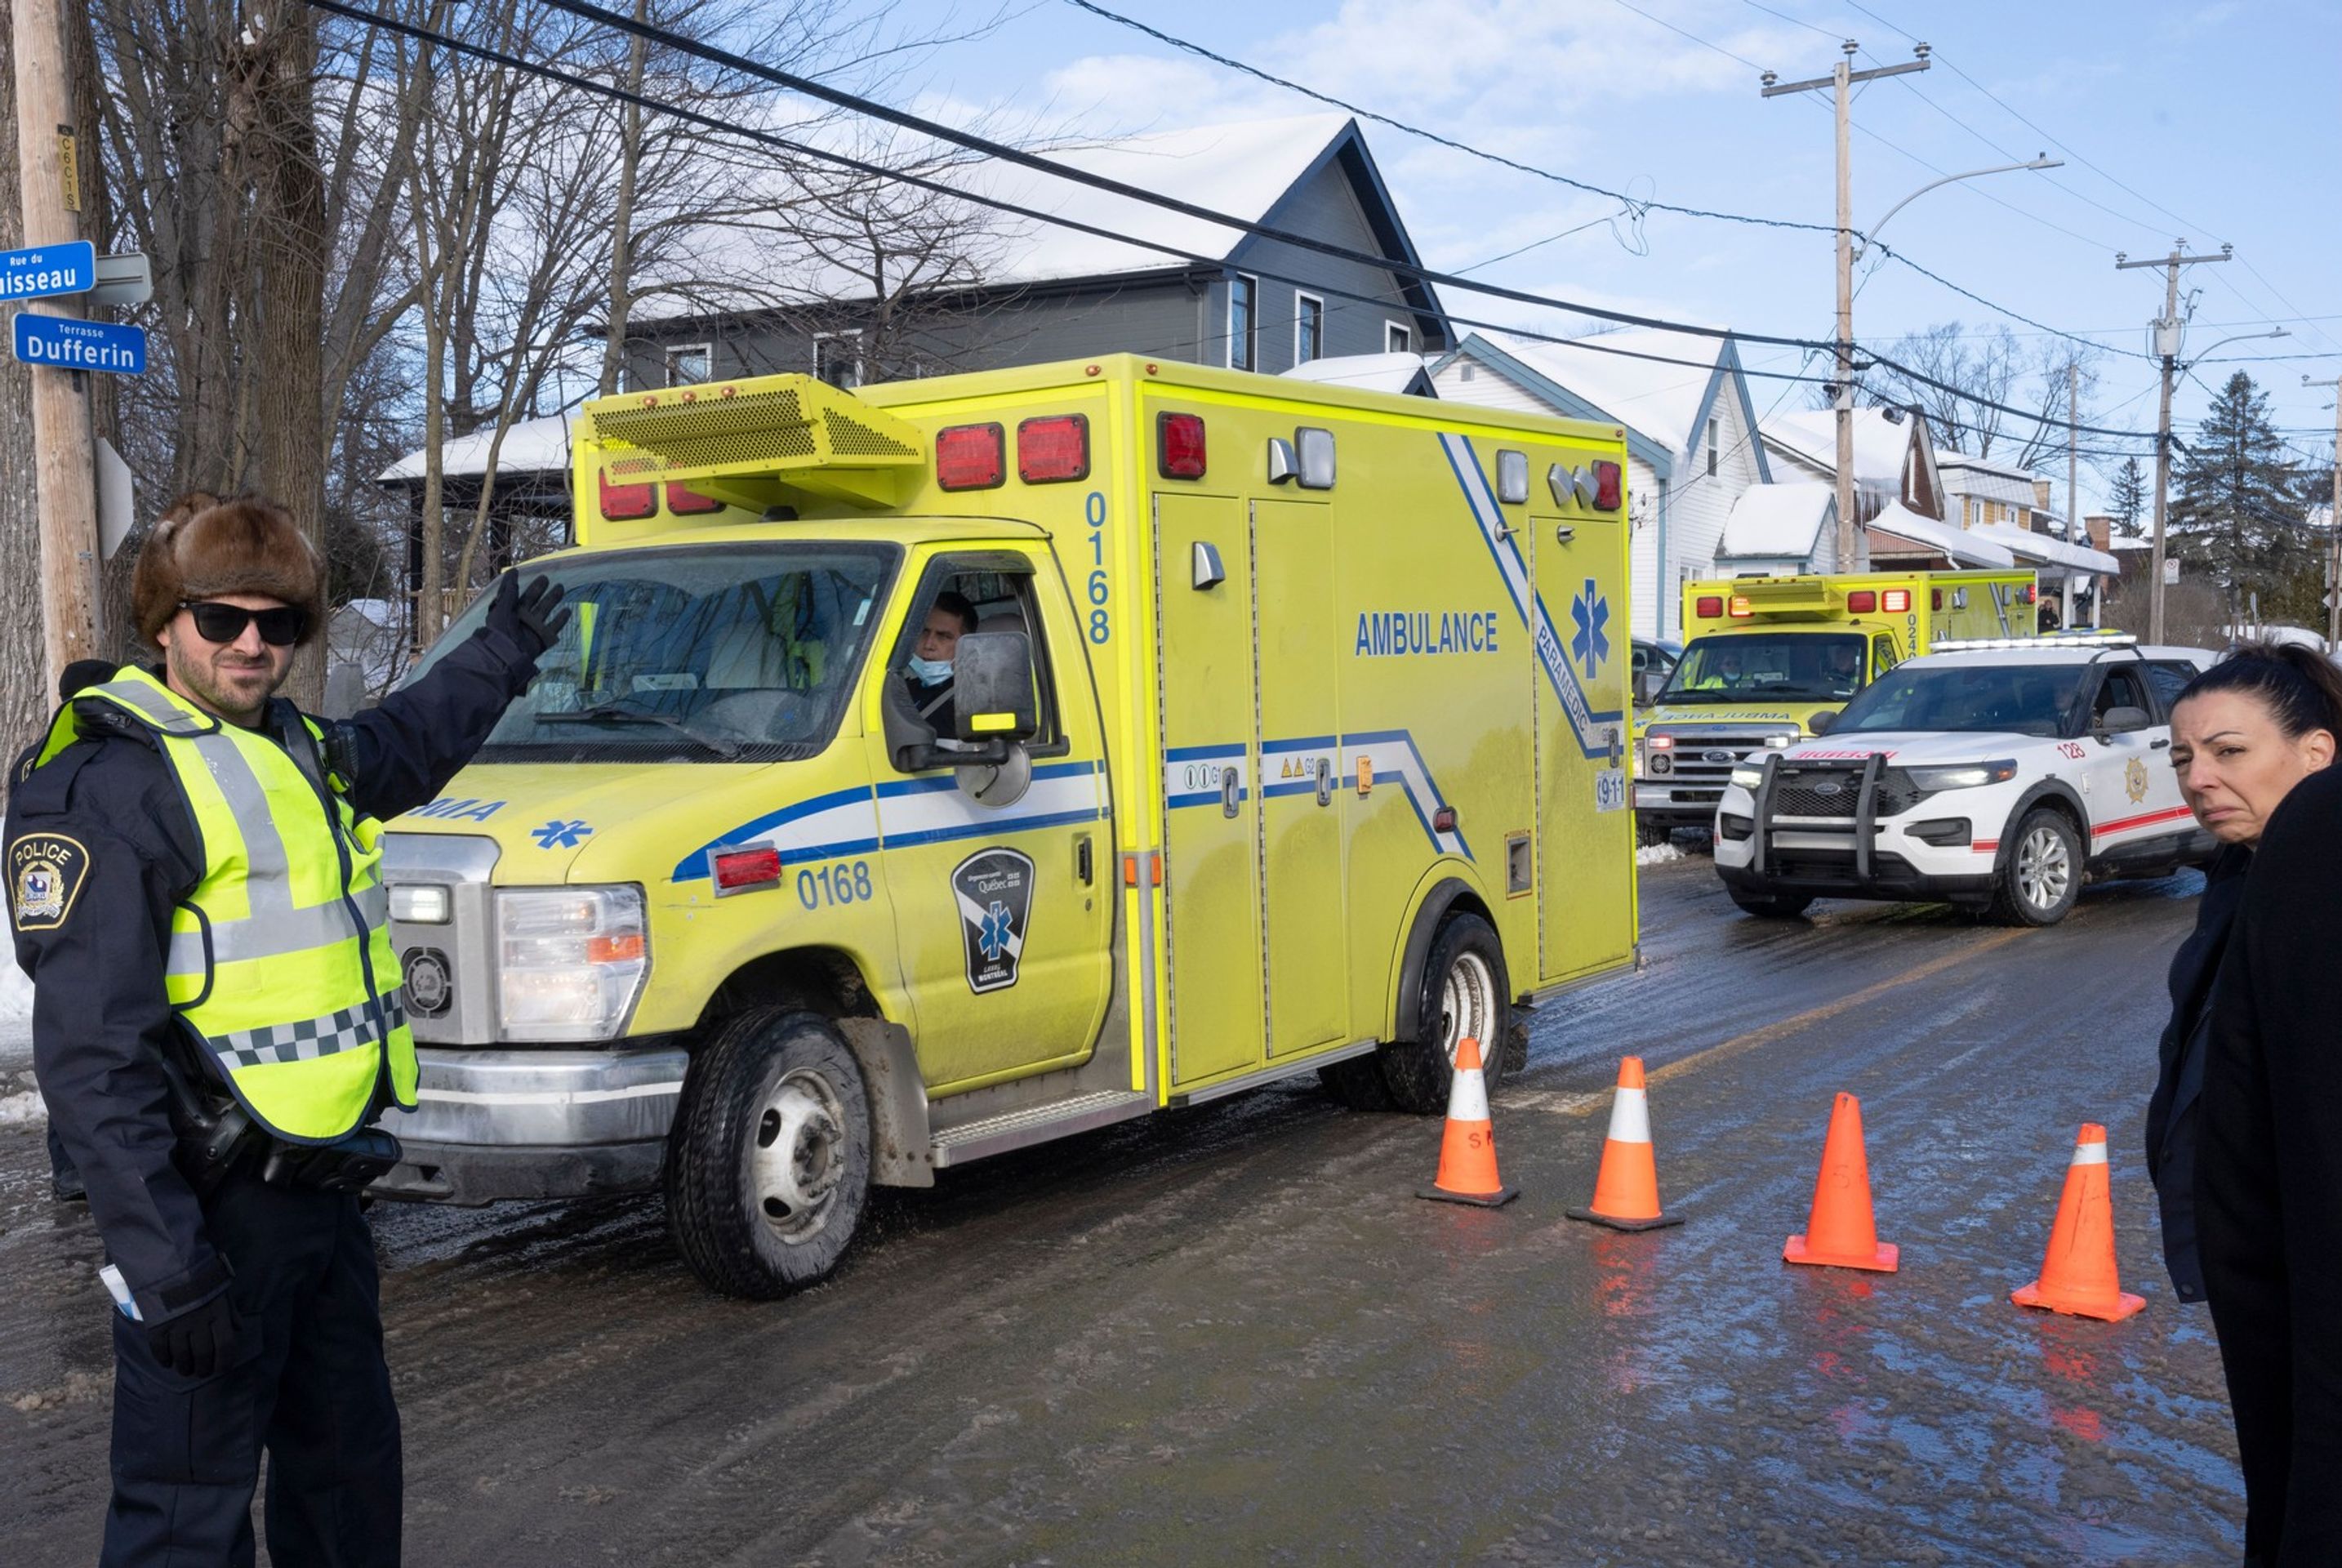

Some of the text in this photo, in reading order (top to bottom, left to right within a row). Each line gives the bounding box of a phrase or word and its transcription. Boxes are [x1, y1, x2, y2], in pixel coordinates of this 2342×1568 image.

[10, 253, 42, 266] Rue du
[59, 323, 104, 338] Terrasse
[27, 335, 134, 368] Dufferin
[1085, 492, 1110, 644] 0168
[1356, 612, 1498, 657] AMBULANCE
[1538, 626, 1587, 732] PARAMEDIC
[2057, 742, 2086, 760] 128
[1211, 766, 1222, 784] G1
[1305, 758, 1315, 774] G2
[16, 842, 72, 866] POLICE
[797, 861, 873, 911] 0168
[978, 879, 1007, 894] Québec
